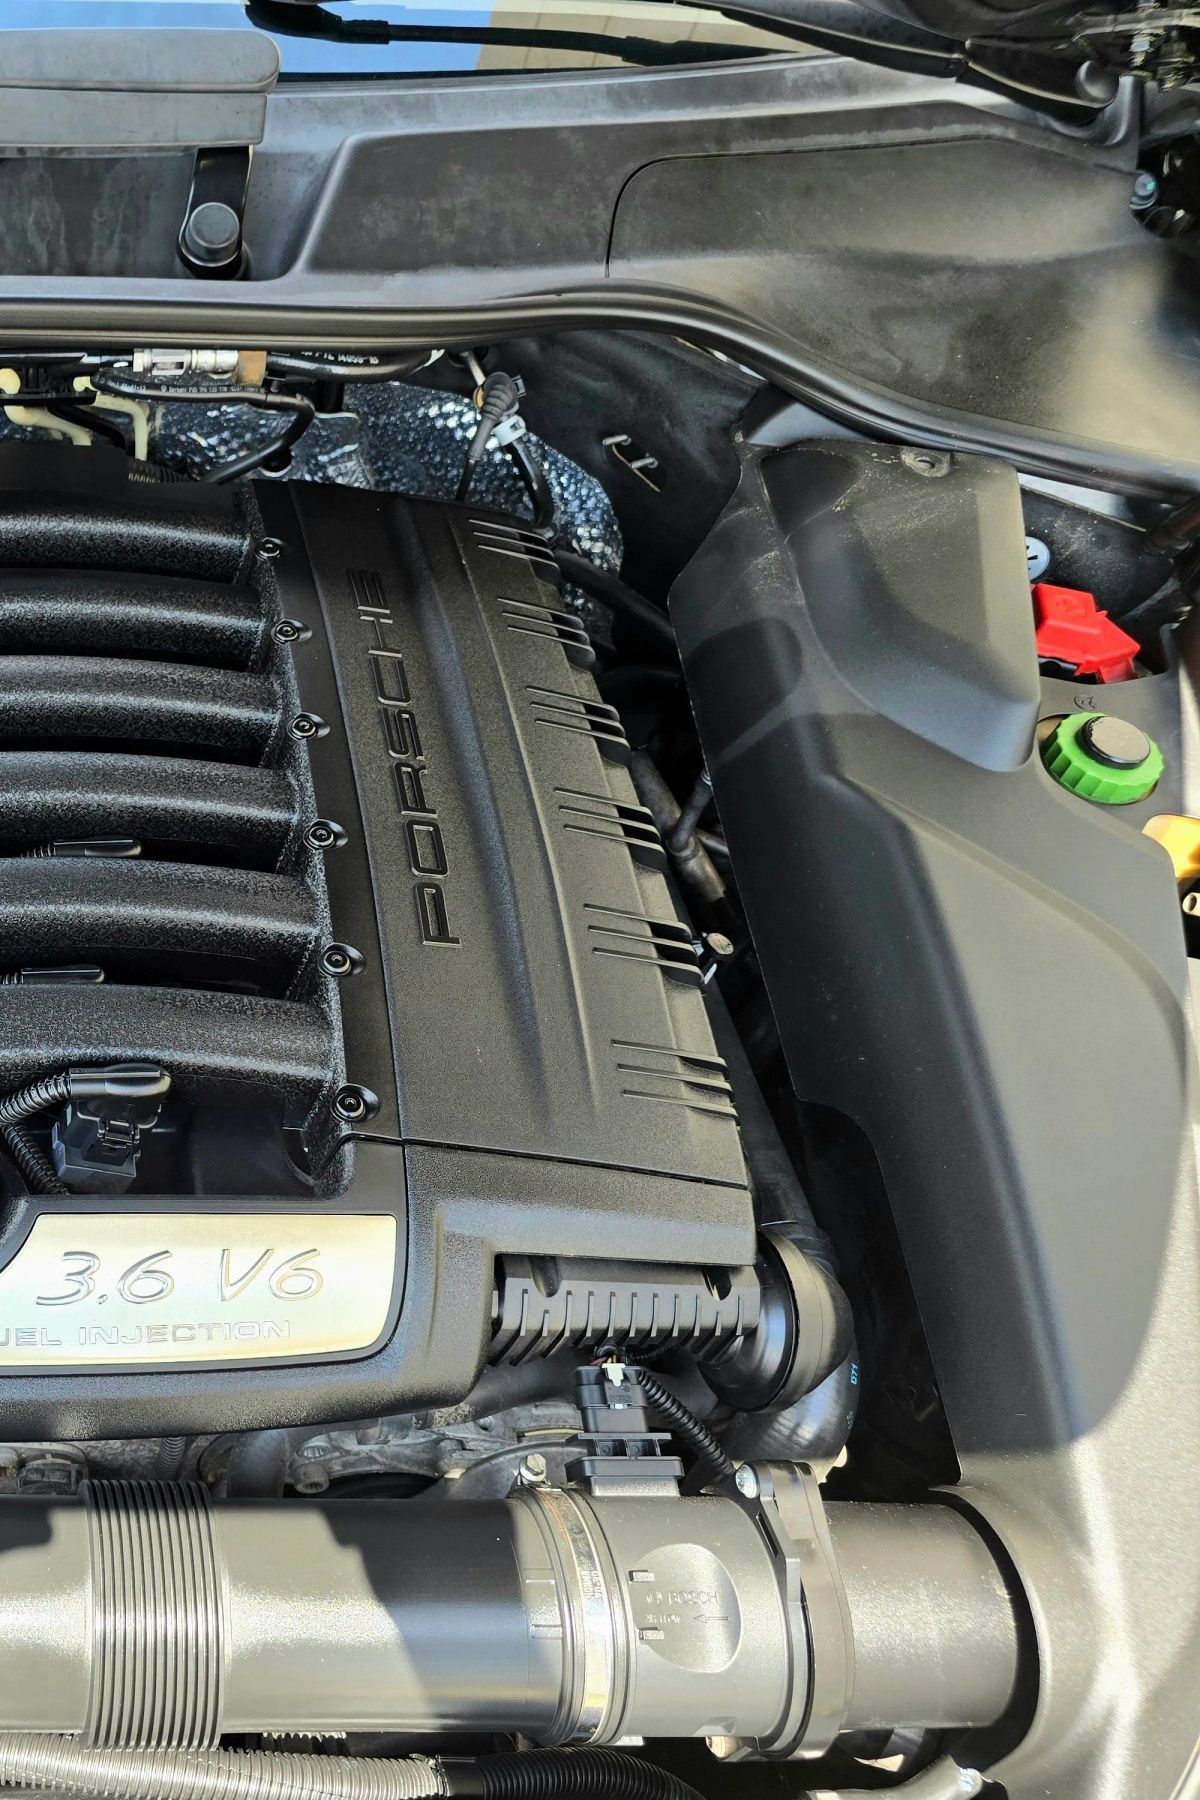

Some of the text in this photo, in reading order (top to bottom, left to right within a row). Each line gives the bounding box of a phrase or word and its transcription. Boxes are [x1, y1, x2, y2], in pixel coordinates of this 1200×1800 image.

[346, 569, 462, 948] PORSCHE
[36, 1248, 324, 1305] 3.6 V6
[78, 1319, 291, 1346] INJECTION
[668, 1590, 719, 1605] BOSCH
